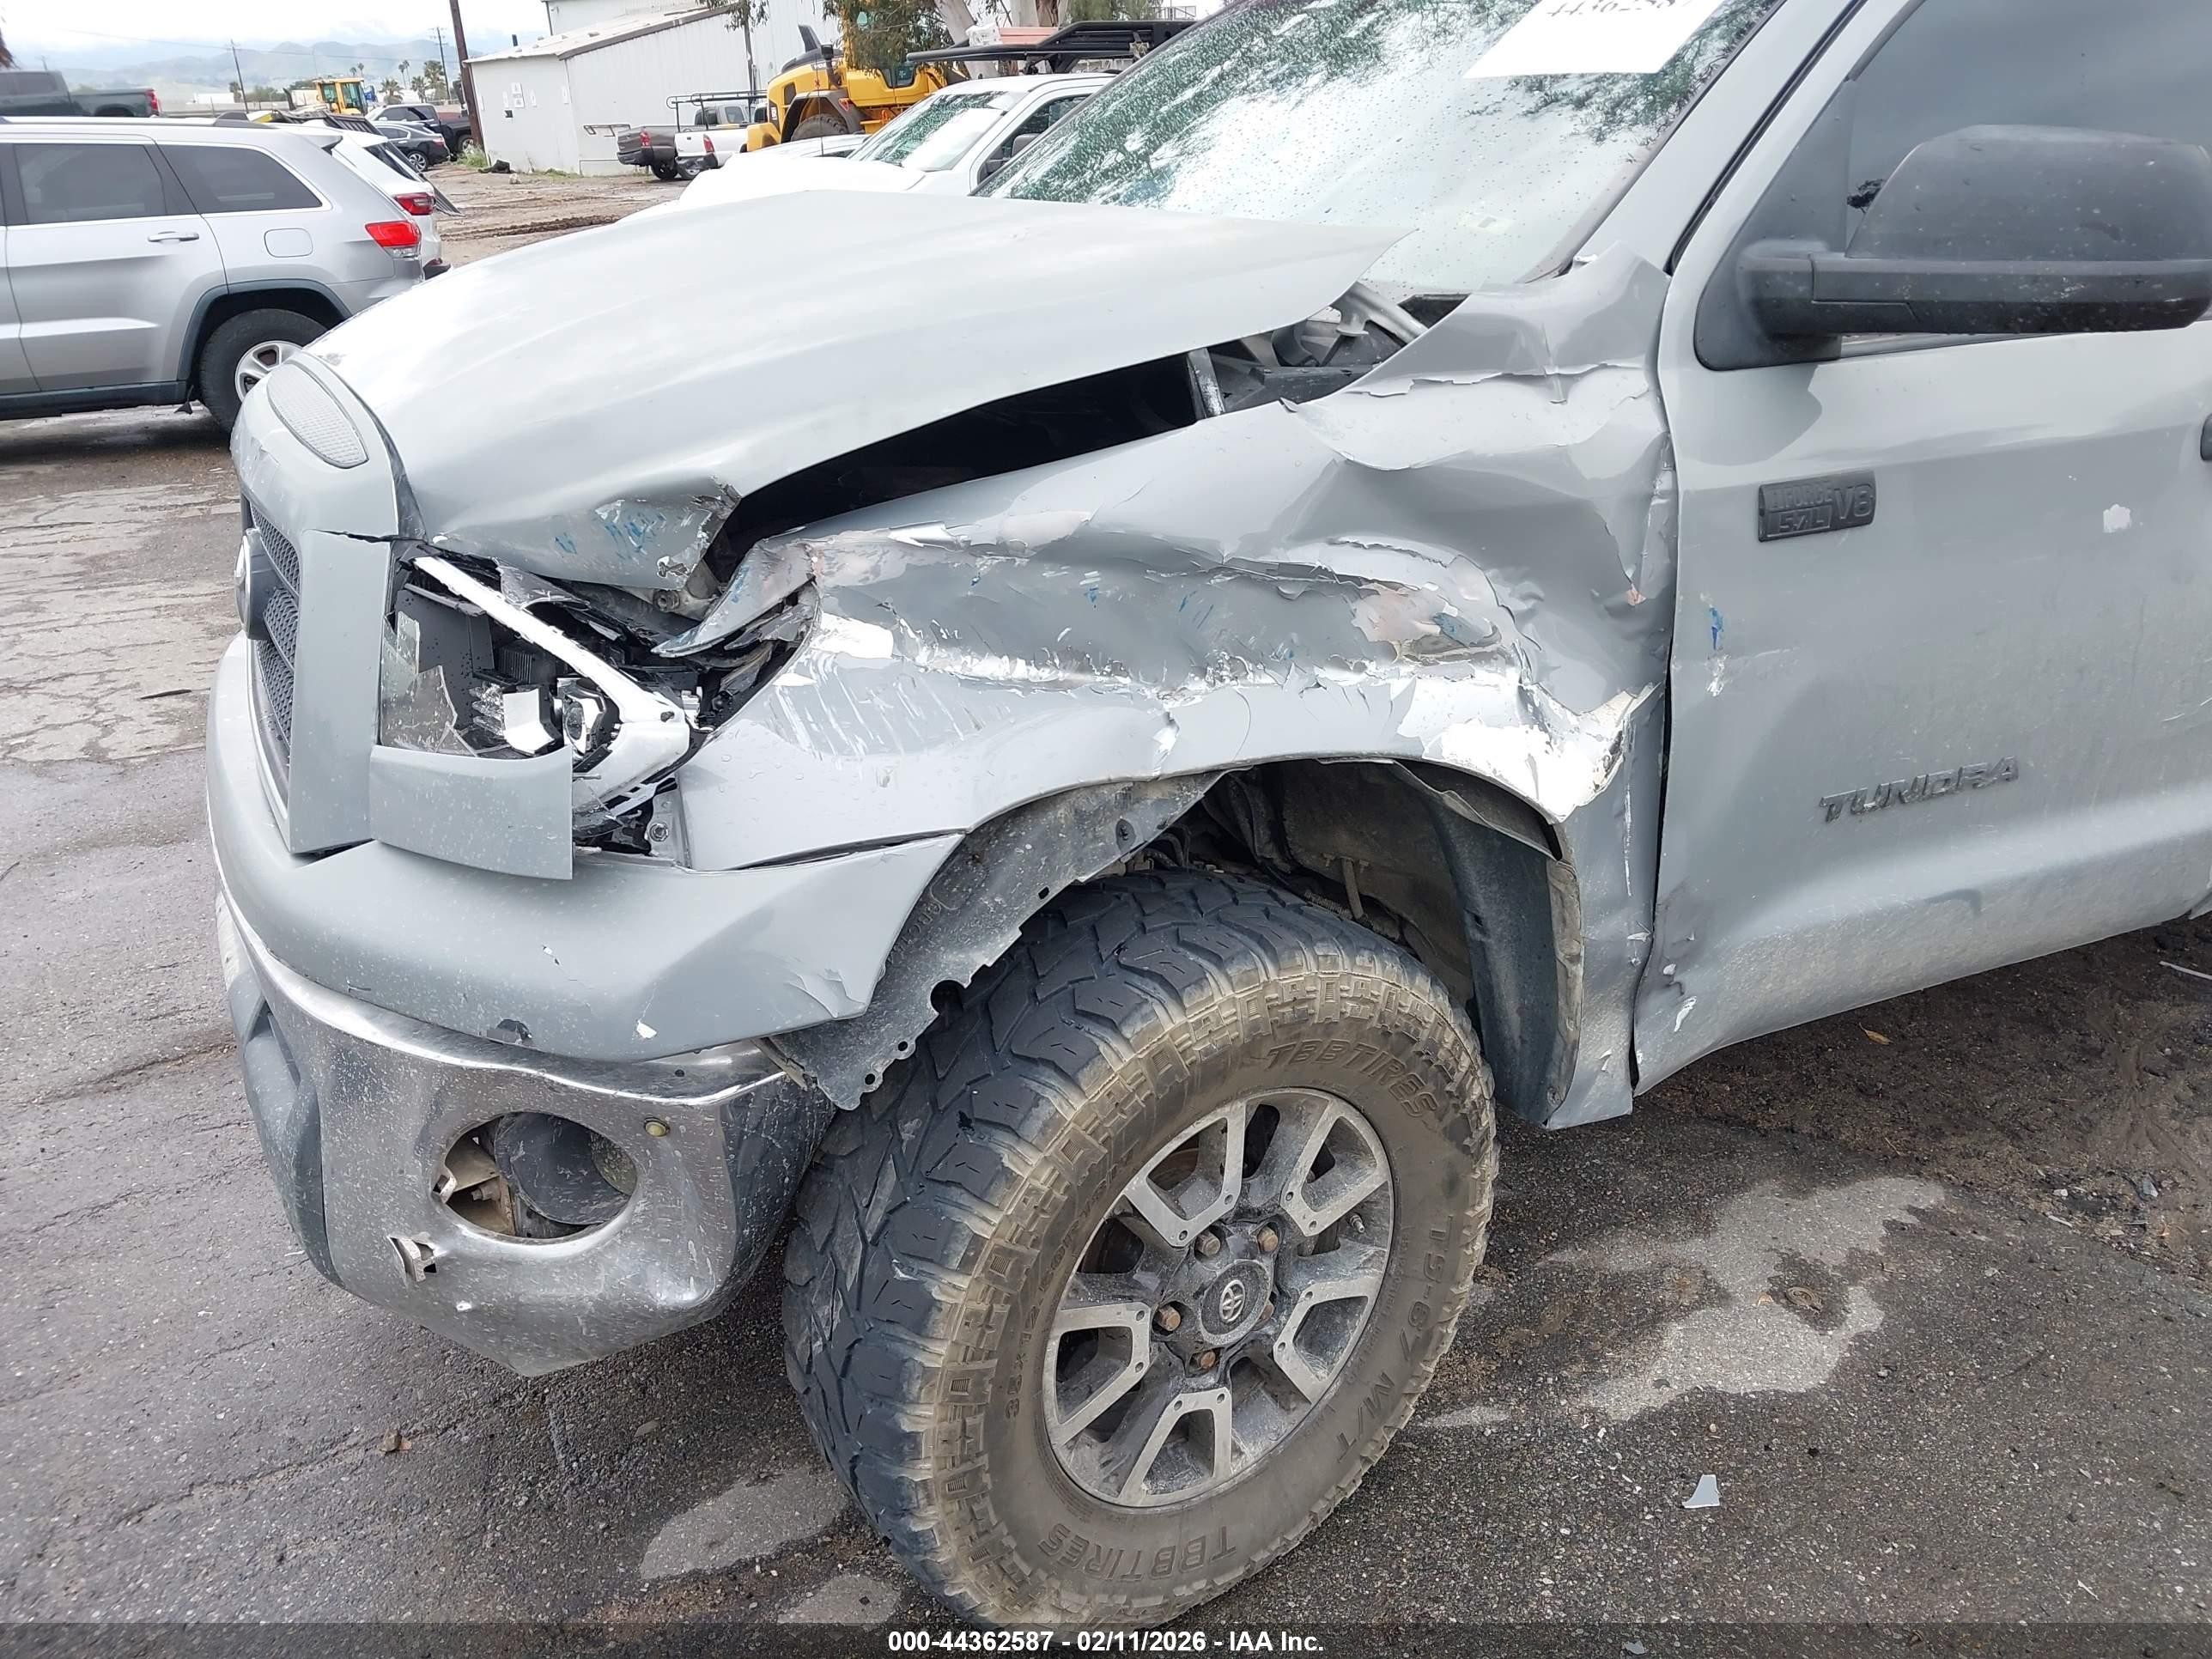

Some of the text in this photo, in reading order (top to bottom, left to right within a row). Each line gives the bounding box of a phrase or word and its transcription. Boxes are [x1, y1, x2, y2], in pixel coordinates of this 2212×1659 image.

[1833, 483, 1875, 520] V8
[1818, 756, 2019, 823] TUNDRA
[1266, 1038, 1440, 1117] TBBTIRES
[1336, 1371, 1395, 1464] M/T
[1036, 1523, 1237, 1583] TBBTIRES
